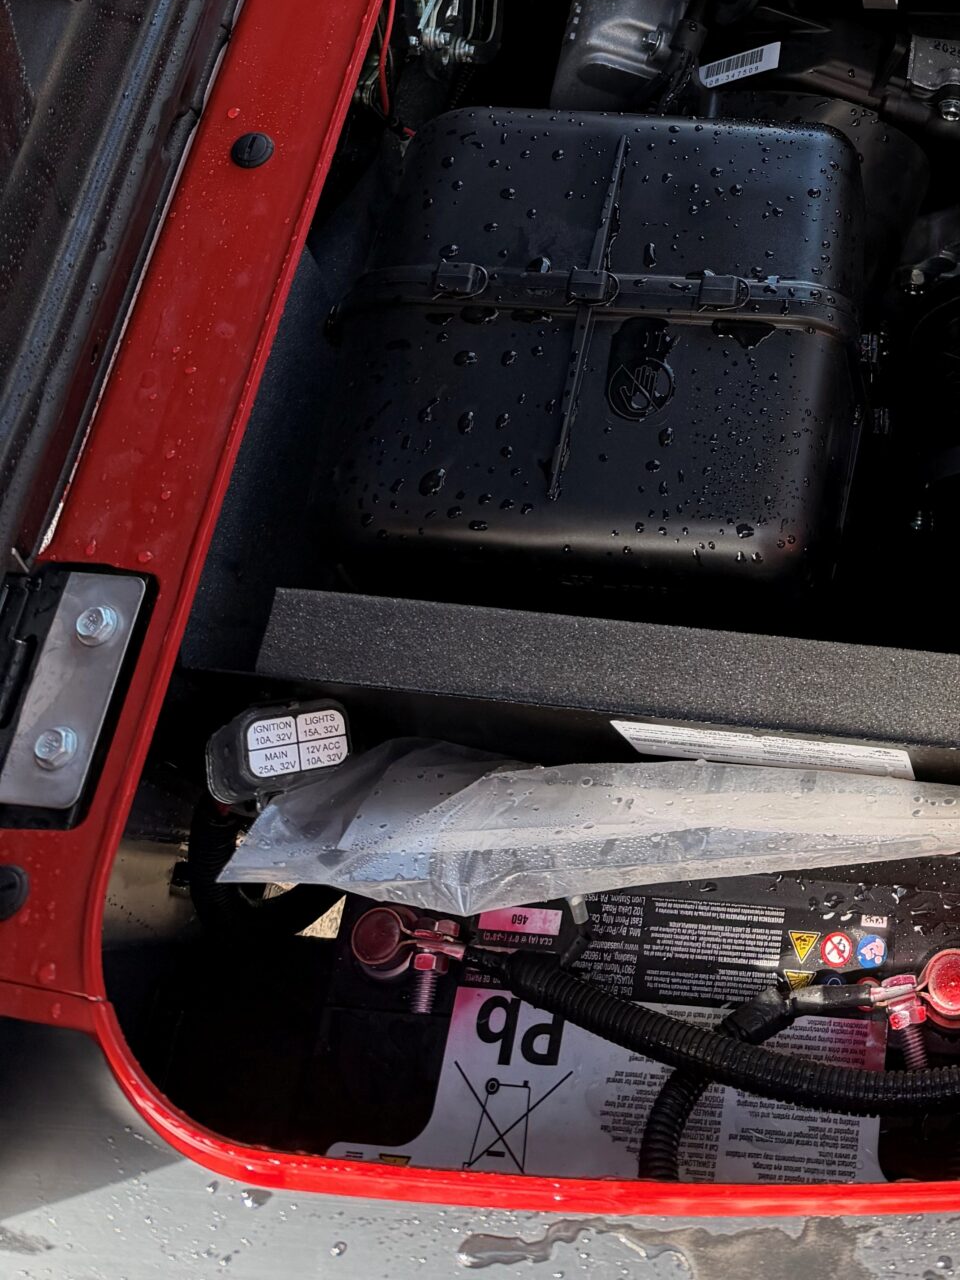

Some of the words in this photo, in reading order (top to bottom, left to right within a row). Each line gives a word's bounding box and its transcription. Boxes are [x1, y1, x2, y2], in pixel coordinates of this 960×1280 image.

[304, 714, 335, 726] LIGHTS
[253, 721, 292, 734] IGNITION
[304, 728, 322, 737] 15A,
[323, 724, 340, 734] 32V
[256, 736, 274, 745] 10A,
[276, 732, 293, 742] 32V
[306, 745, 322, 754] 12V
[322, 741, 341, 752] ACC
[264, 751, 288, 762] MAIN
[306, 757, 325, 766] 10A,
[326, 752, 343, 763] 32V
[258, 764, 278, 774] 25A,
[279, 760, 297, 771] 32V
[600, 892, 608, 902] PA
[511, 914, 528, 925] 460
[630, 916, 642, 926] East
[528, 935, 538, 945] (A)
[539, 936, 552, 946] CCA
[602, 951, 612, 961] PA
[476, 995, 565, 1066] Pb
